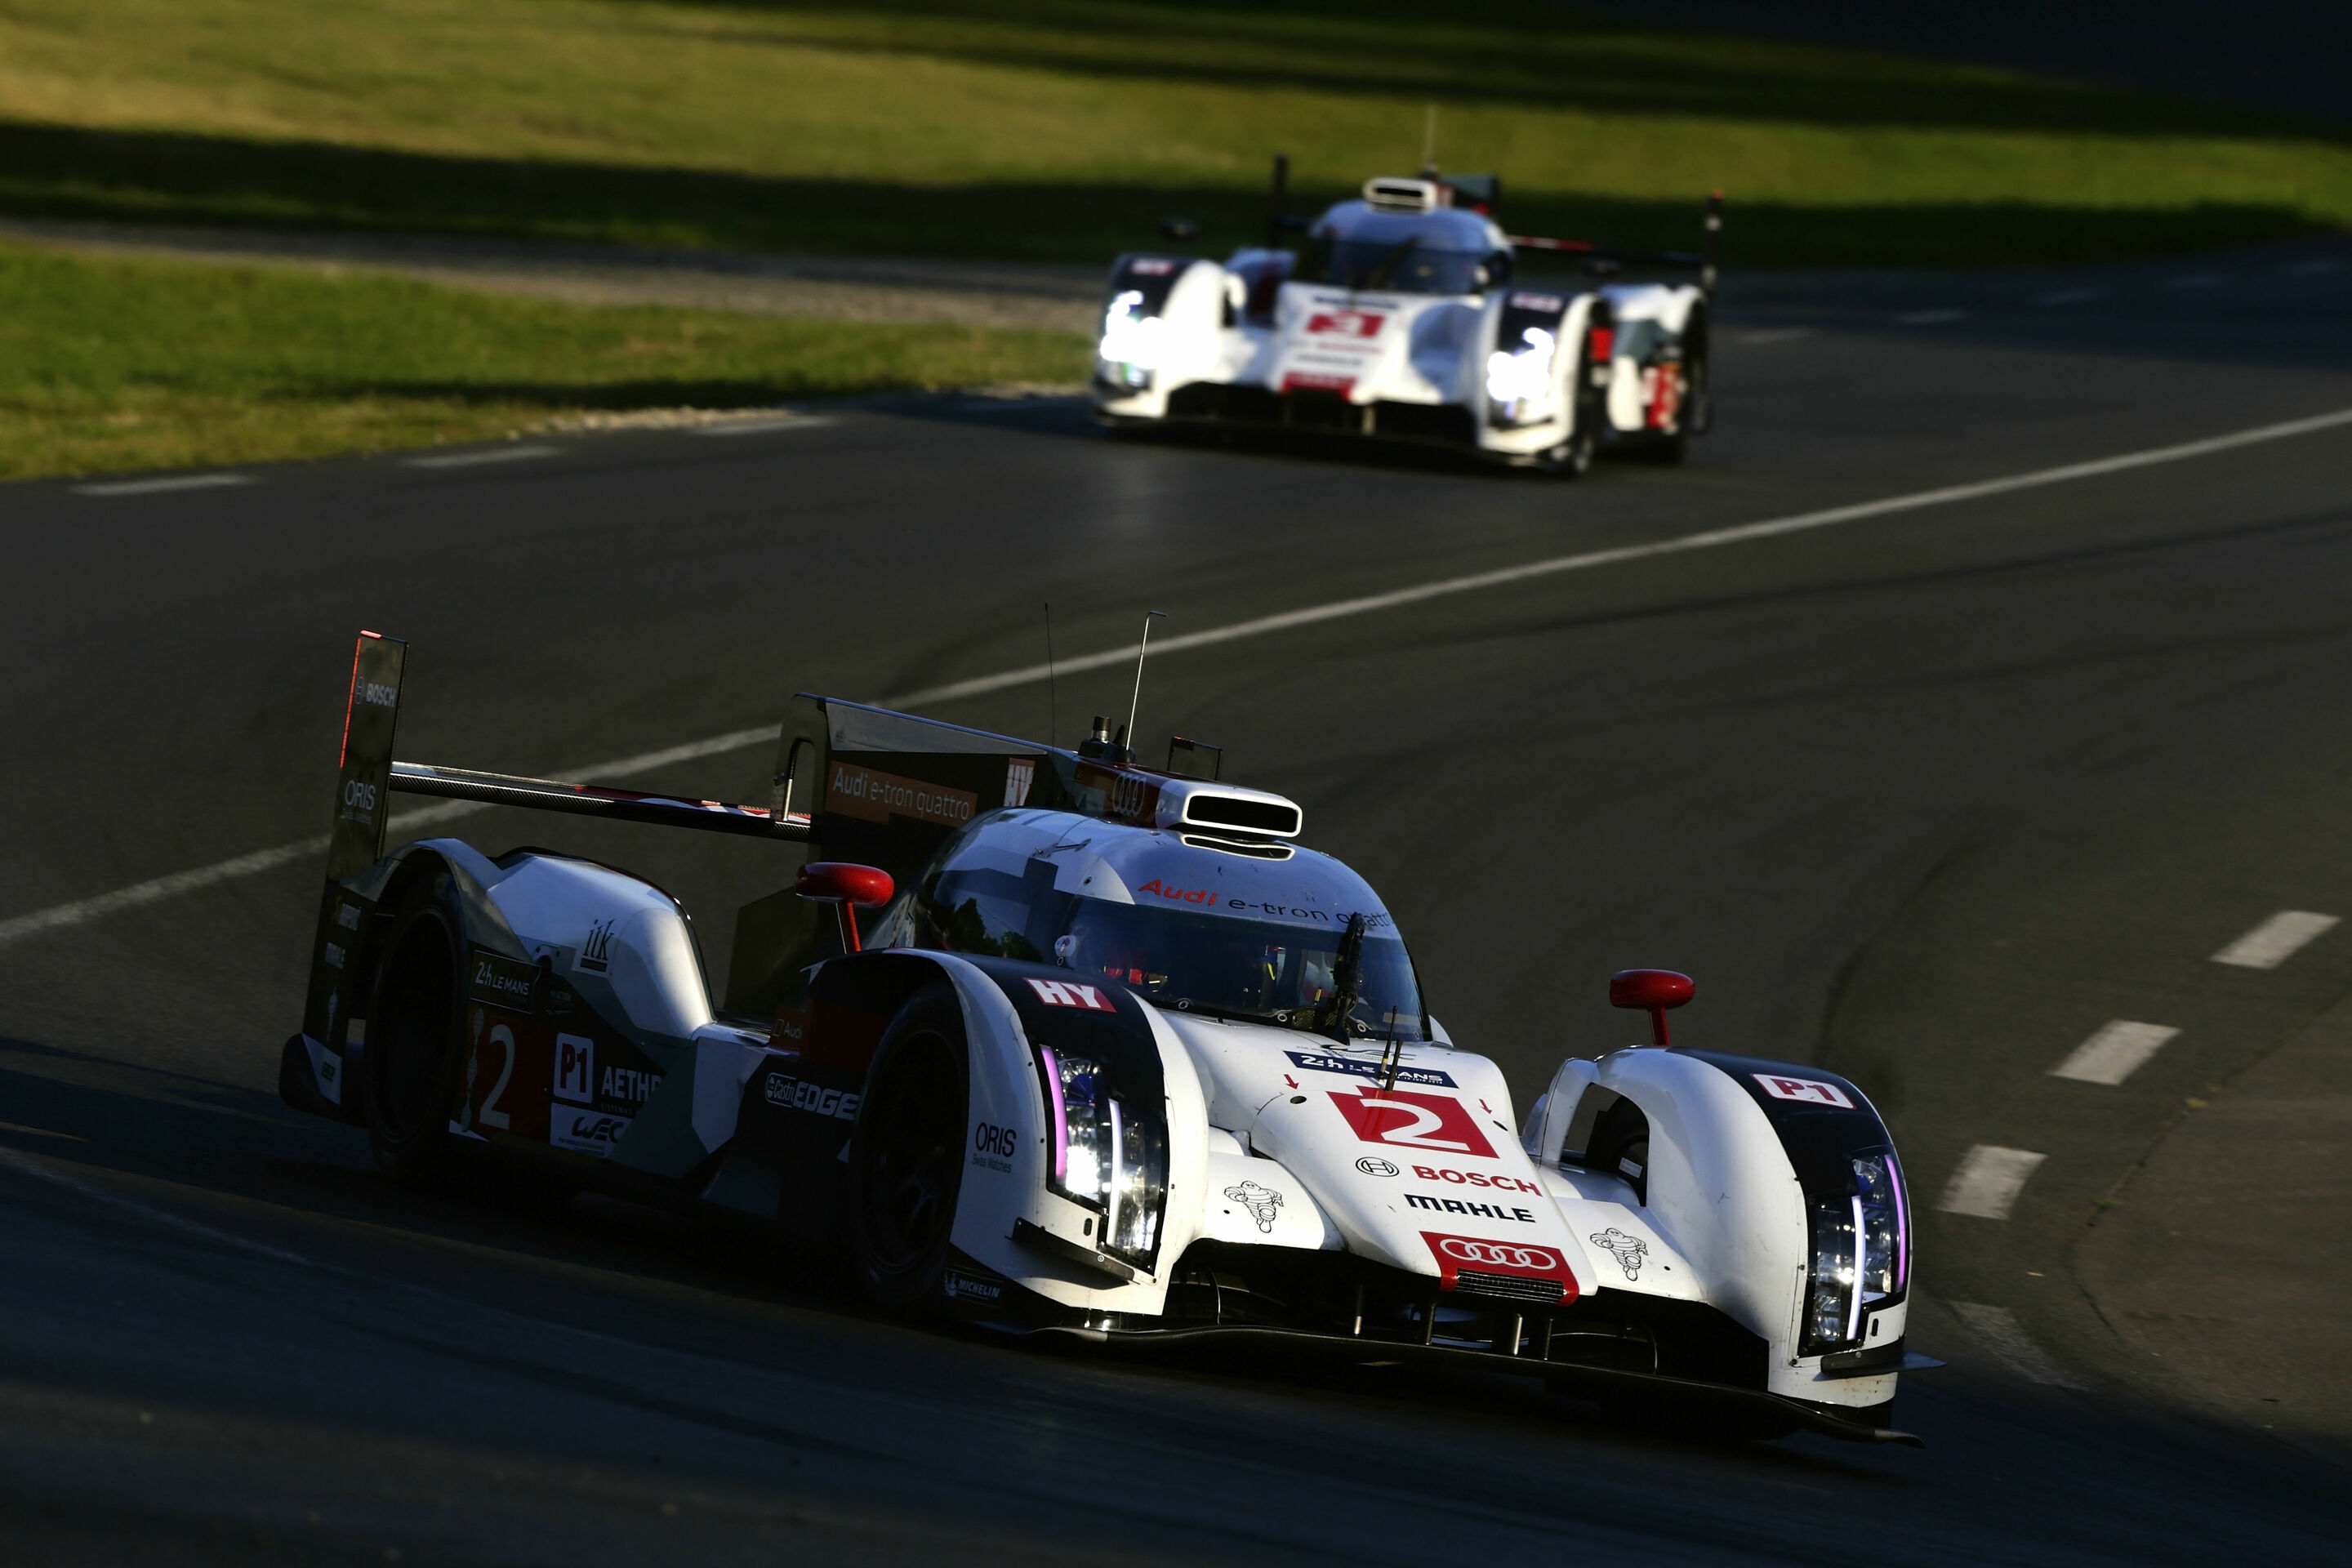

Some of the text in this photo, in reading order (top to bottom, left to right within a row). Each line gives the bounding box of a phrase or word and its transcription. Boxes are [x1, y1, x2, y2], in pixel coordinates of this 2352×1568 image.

[367, 684, 397, 707] BOSCH
[345, 780, 376, 810] ORIS
[833, 767, 970, 820] Audi e-tron quattro
[1138, 880, 1392, 927] Audi e-tron qattr
[492, 974, 505, 991] LE
[504, 979, 529, 996] MANS
[1028, 979, 1101, 1008] HY
[479, 1024, 515, 1122] 2
[560, 1044, 587, 1093] P1
[1349, 1065, 1374, 1073] LE
[1383, 1068, 1443, 1082] ANS
[793, 1080, 861, 1121] EDGE
[1771, 1079, 1837, 1102] P1
[572, 1116, 624, 1143] WEC
[976, 1122, 1016, 1157] ORIS
[1361, 1098, 1471, 1151] 2
[1412, 1165, 1543, 1196] BOSCH
[1404, 1194, 1536, 1223] MAHLE
[957, 1278, 1000, 1298] MICHELIN
